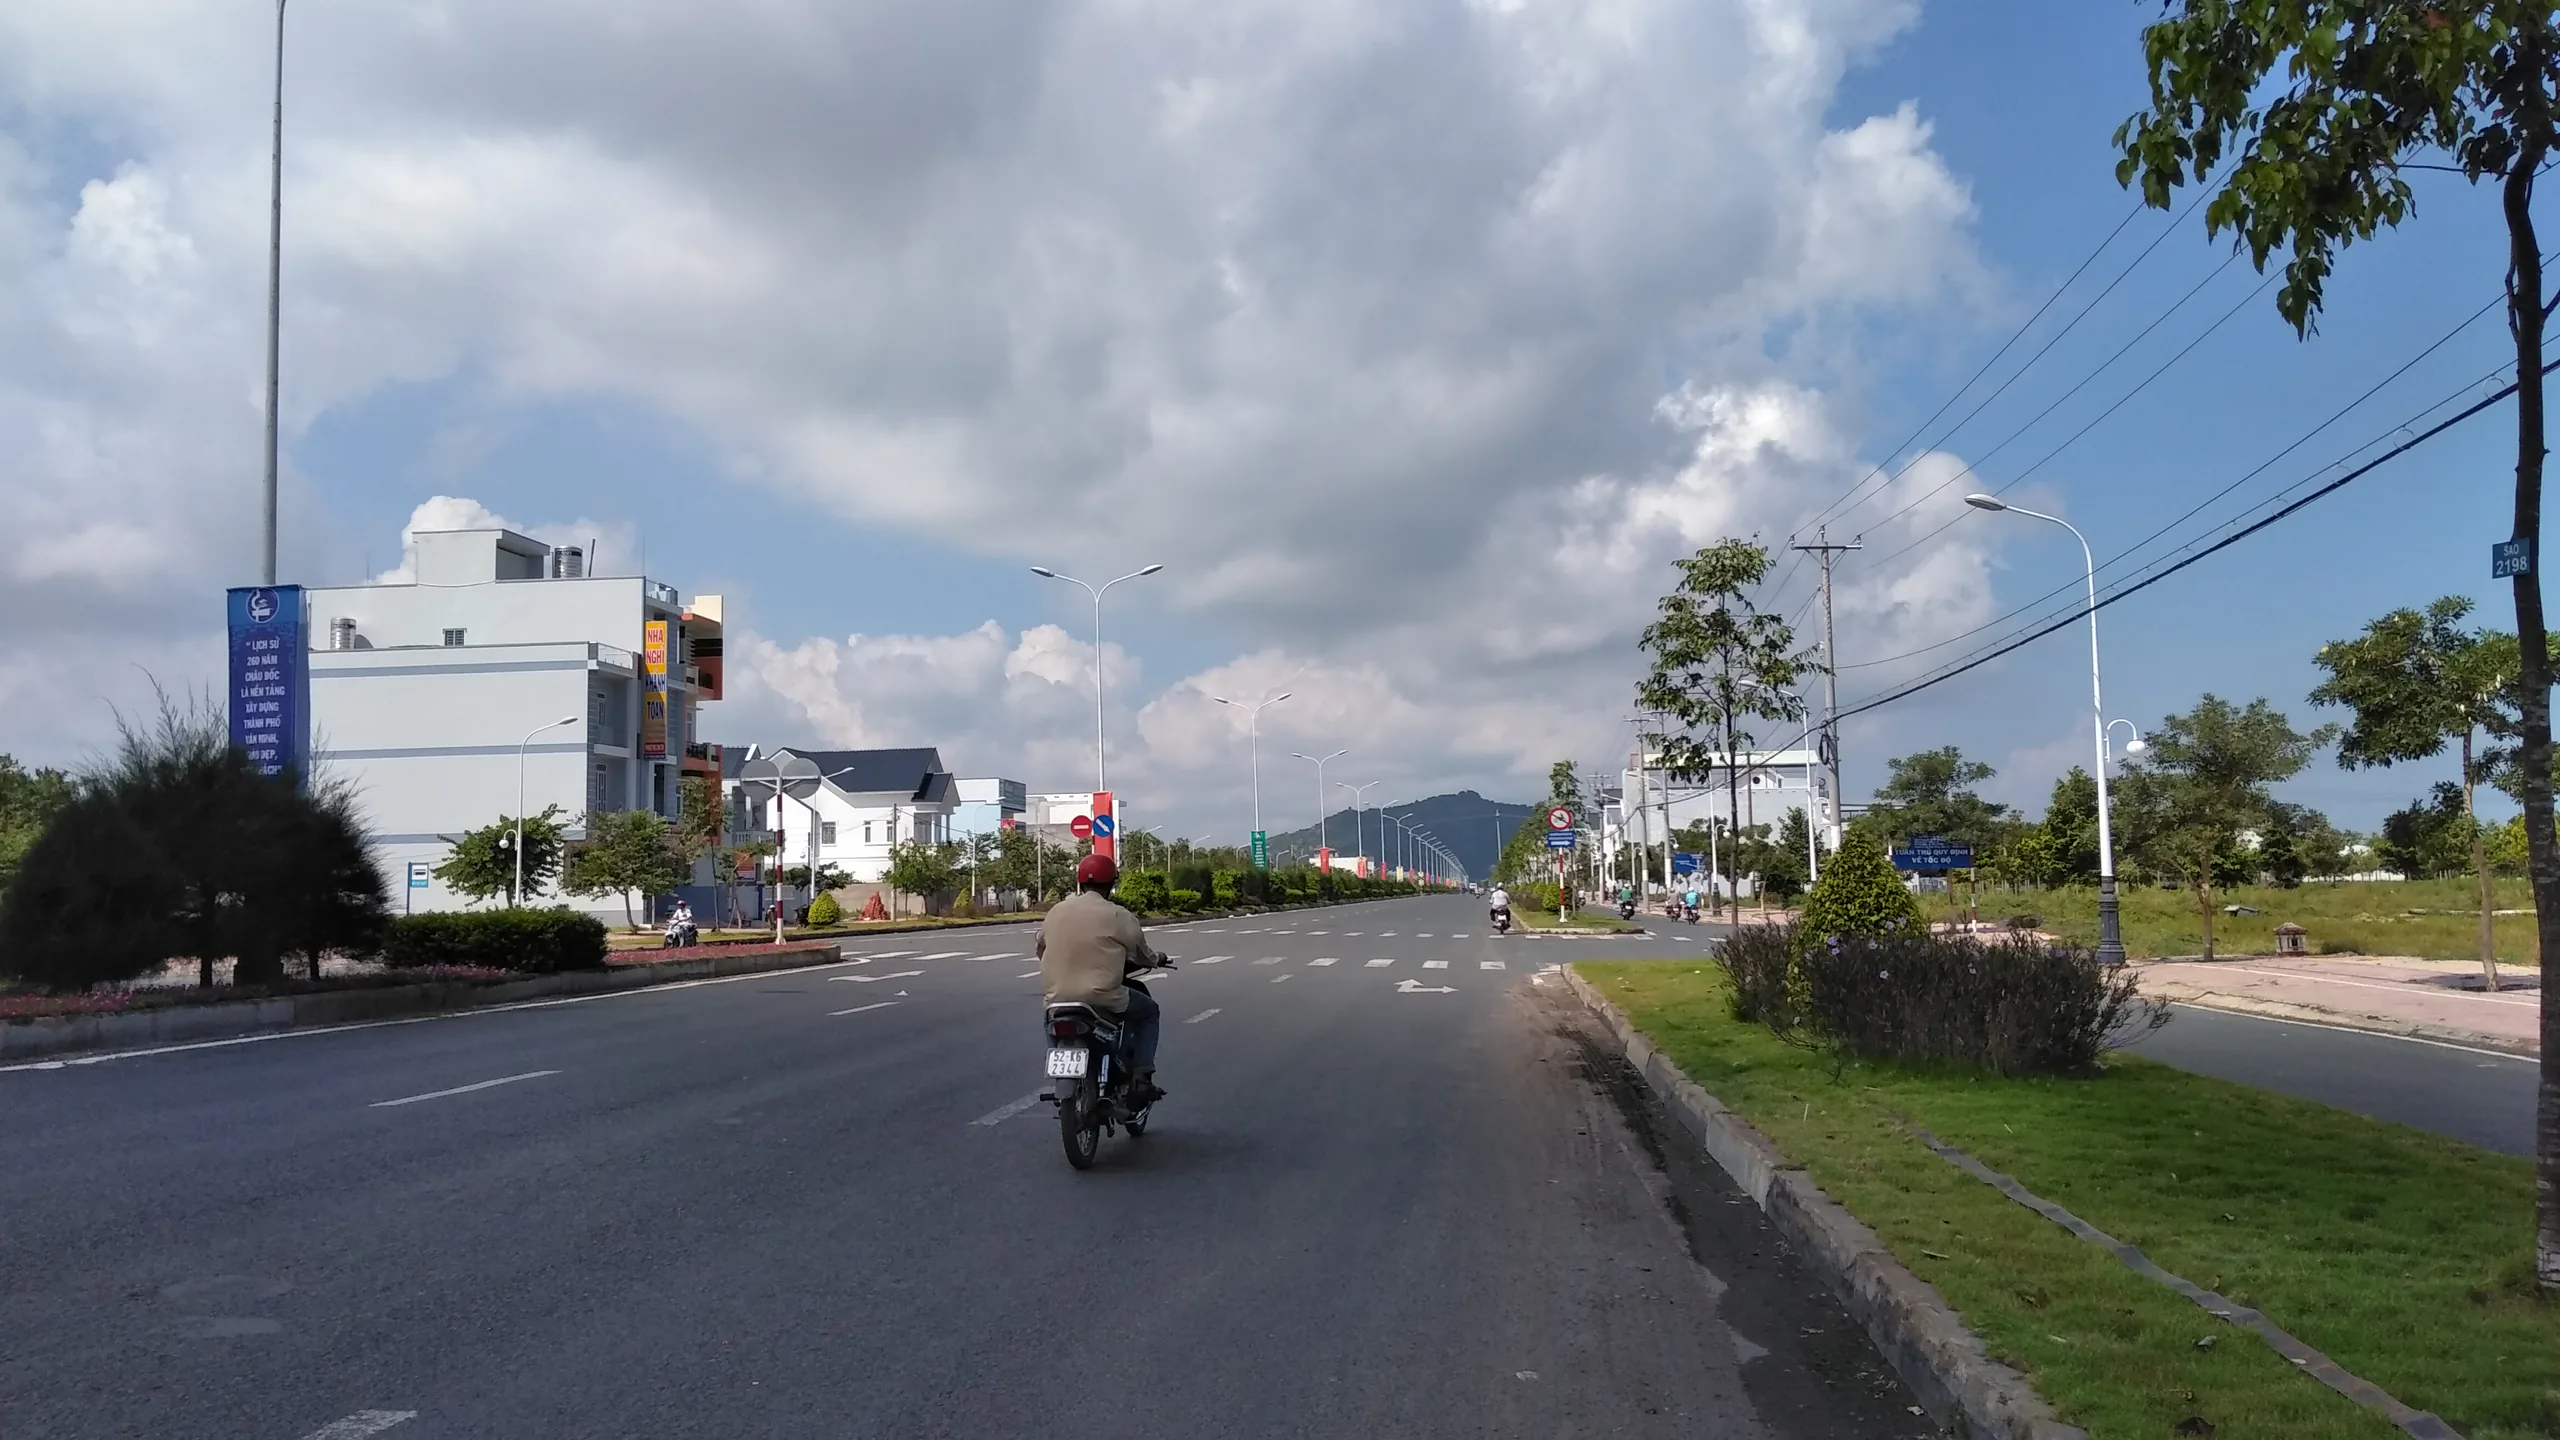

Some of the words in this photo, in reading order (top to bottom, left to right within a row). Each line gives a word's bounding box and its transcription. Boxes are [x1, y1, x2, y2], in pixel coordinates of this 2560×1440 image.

[2504, 544, 2519, 556] SAO
[2496, 556, 2527, 575] 2198
[647, 624, 664, 643] NHÀ
[252, 639, 268, 652] LỊCH
[269, 636, 280, 649] SỬ
[247, 656, 260, 666] 260
[261, 653, 278, 665] NĂM
[646, 644, 665, 664] NGHỈ
[245, 669, 263, 682] CHÂU
[264, 667, 280, 681] ĐỐC
[241, 686, 249, 698] LÀ
[265, 683, 285, 696] TẢNG
[245, 701, 258, 713] XÂY
[259, 700, 279, 714] DỰNG
[243, 716, 264, 729] THÀNH
[265, 714, 282, 728] PHỐ
[1923, 855, 1939, 864] TỐC
[1940, 855, 1952, 865] ĐỘ
[1051, 1063, 1080, 1075] 2344
